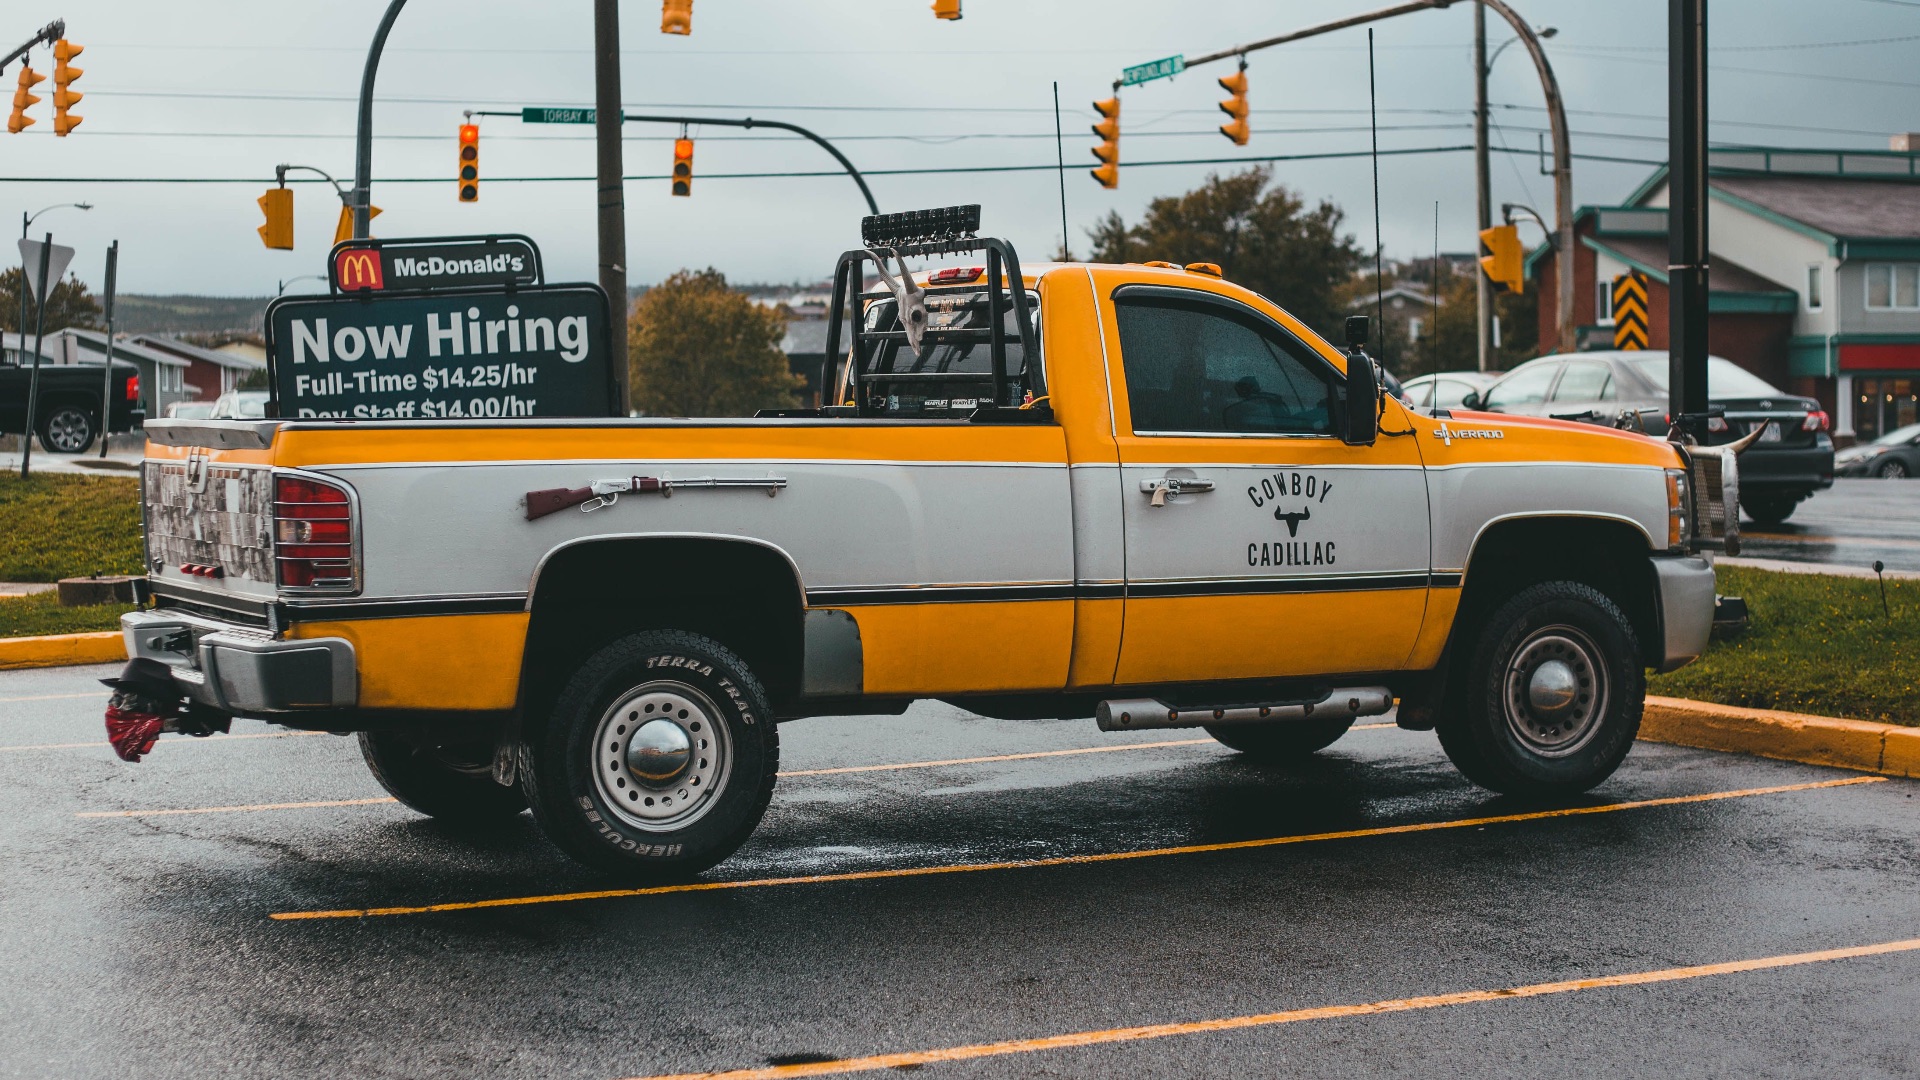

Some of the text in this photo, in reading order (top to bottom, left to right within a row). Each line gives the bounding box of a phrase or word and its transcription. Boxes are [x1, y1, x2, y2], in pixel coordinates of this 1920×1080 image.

[543, 109, 582, 123] TORBAY
[393, 253, 524, 277] McDonald's
[290, 304, 589, 364] Now Hiring
[295, 362, 537, 397] Full-Time $14.25/hr
[420, 395, 536, 417] $14.00/hr
[1433, 428, 1504, 440] SILVERADO
[1247, 472, 1333, 508] COWBOY
[1247, 541, 1336, 567] CADILLAC
[647, 655, 755, 725] TERRA TRAC
[578, 795, 683, 857] HERCULES
